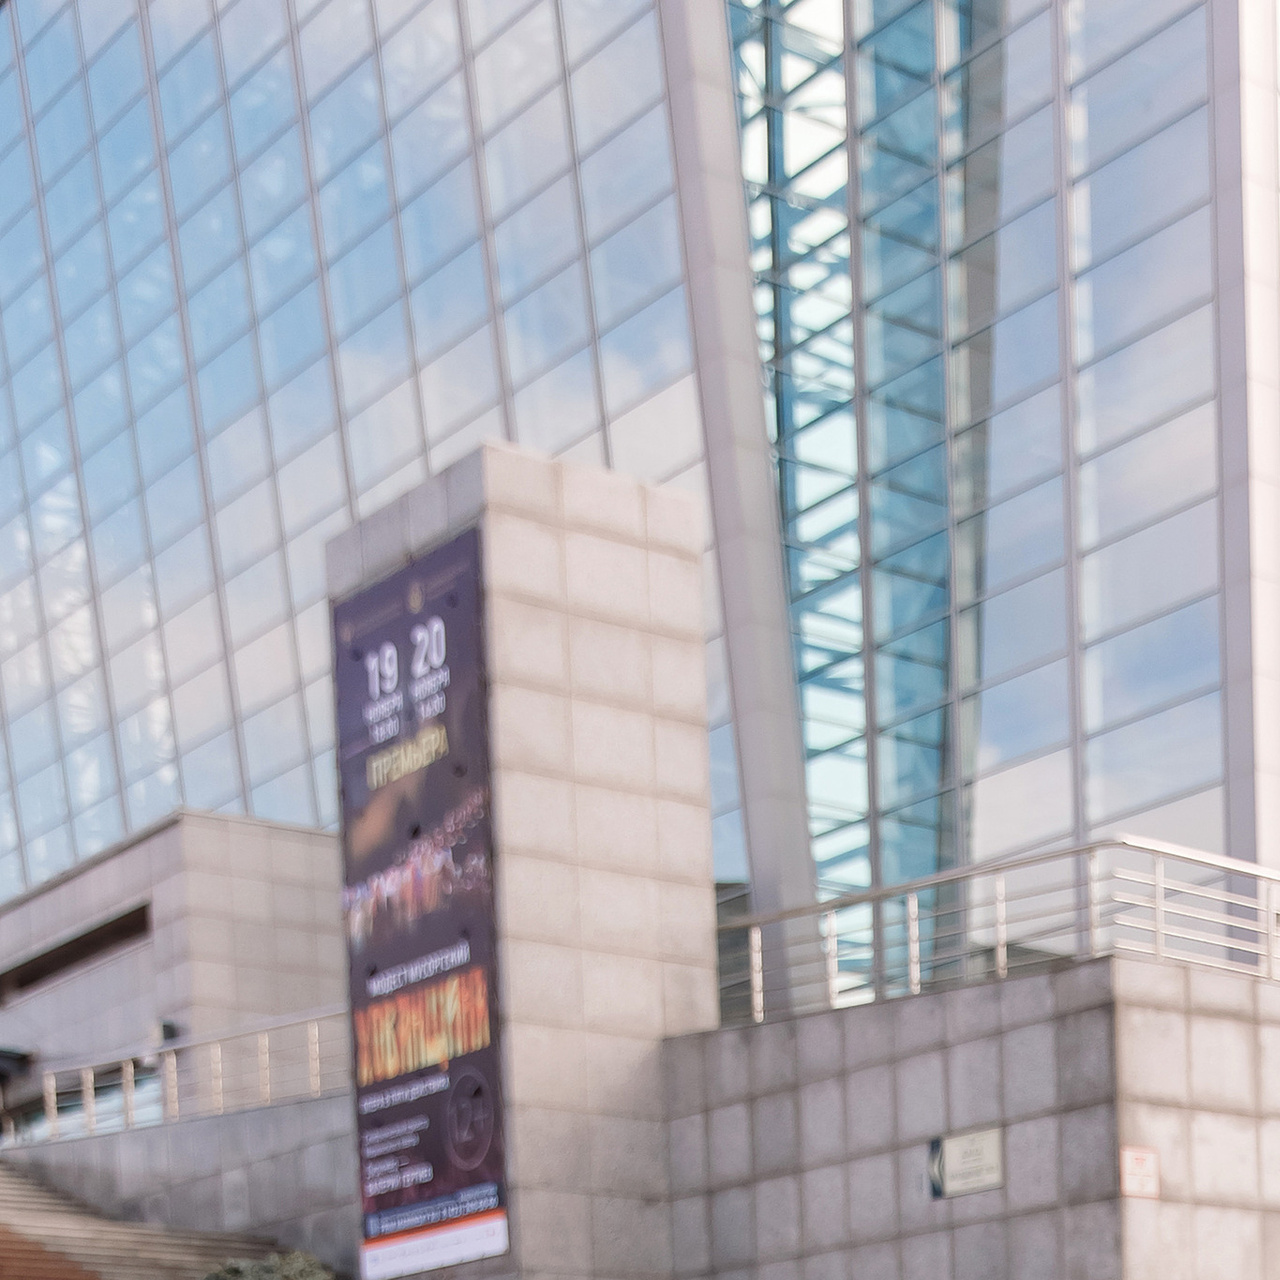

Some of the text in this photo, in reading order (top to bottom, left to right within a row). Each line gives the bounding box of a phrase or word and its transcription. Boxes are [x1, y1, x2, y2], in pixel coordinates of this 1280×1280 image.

[365, 641, 399, 701] 19
[410, 615, 446, 678] 20
[367, 725, 449, 790] ПРЕМЬЕРА
